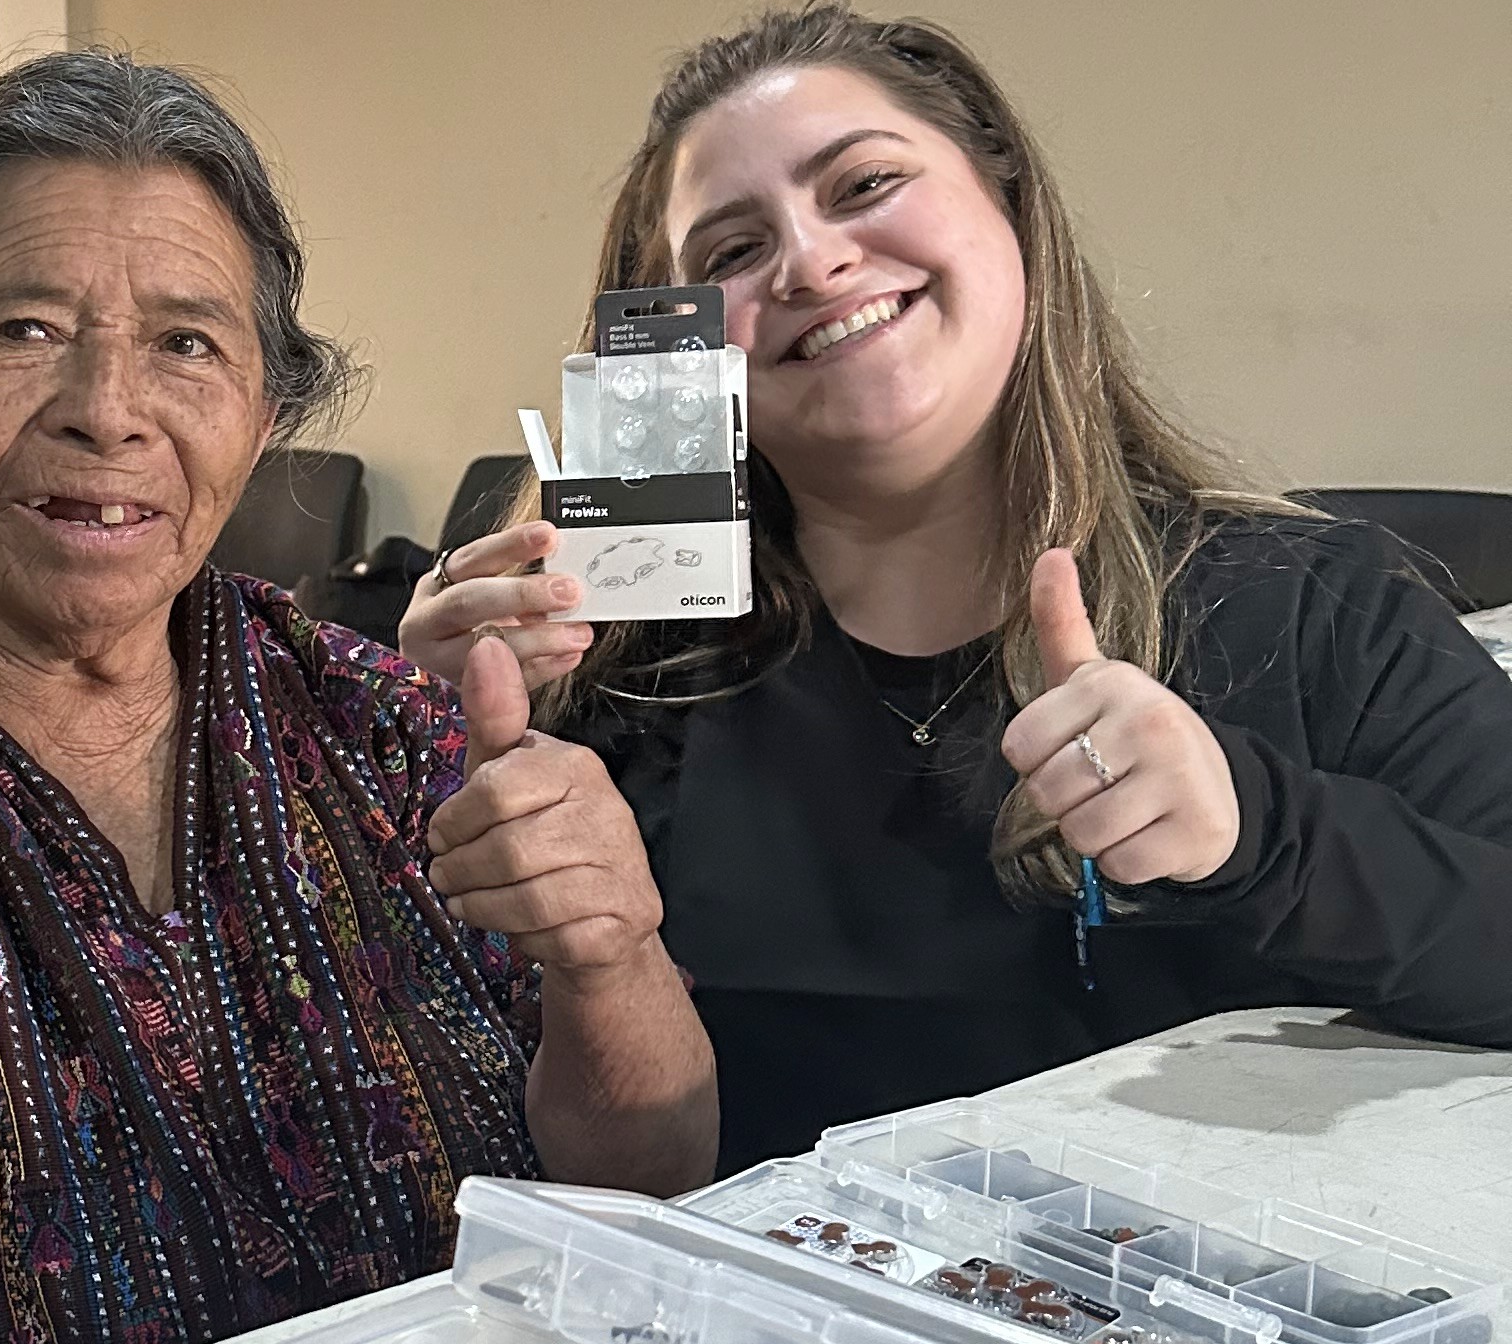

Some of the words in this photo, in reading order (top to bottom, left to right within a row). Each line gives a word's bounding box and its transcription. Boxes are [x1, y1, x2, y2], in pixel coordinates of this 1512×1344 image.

[561, 494, 592, 504] miniFit
[561, 506, 609, 518] ProWax
[680, 593, 726, 606] oticon
